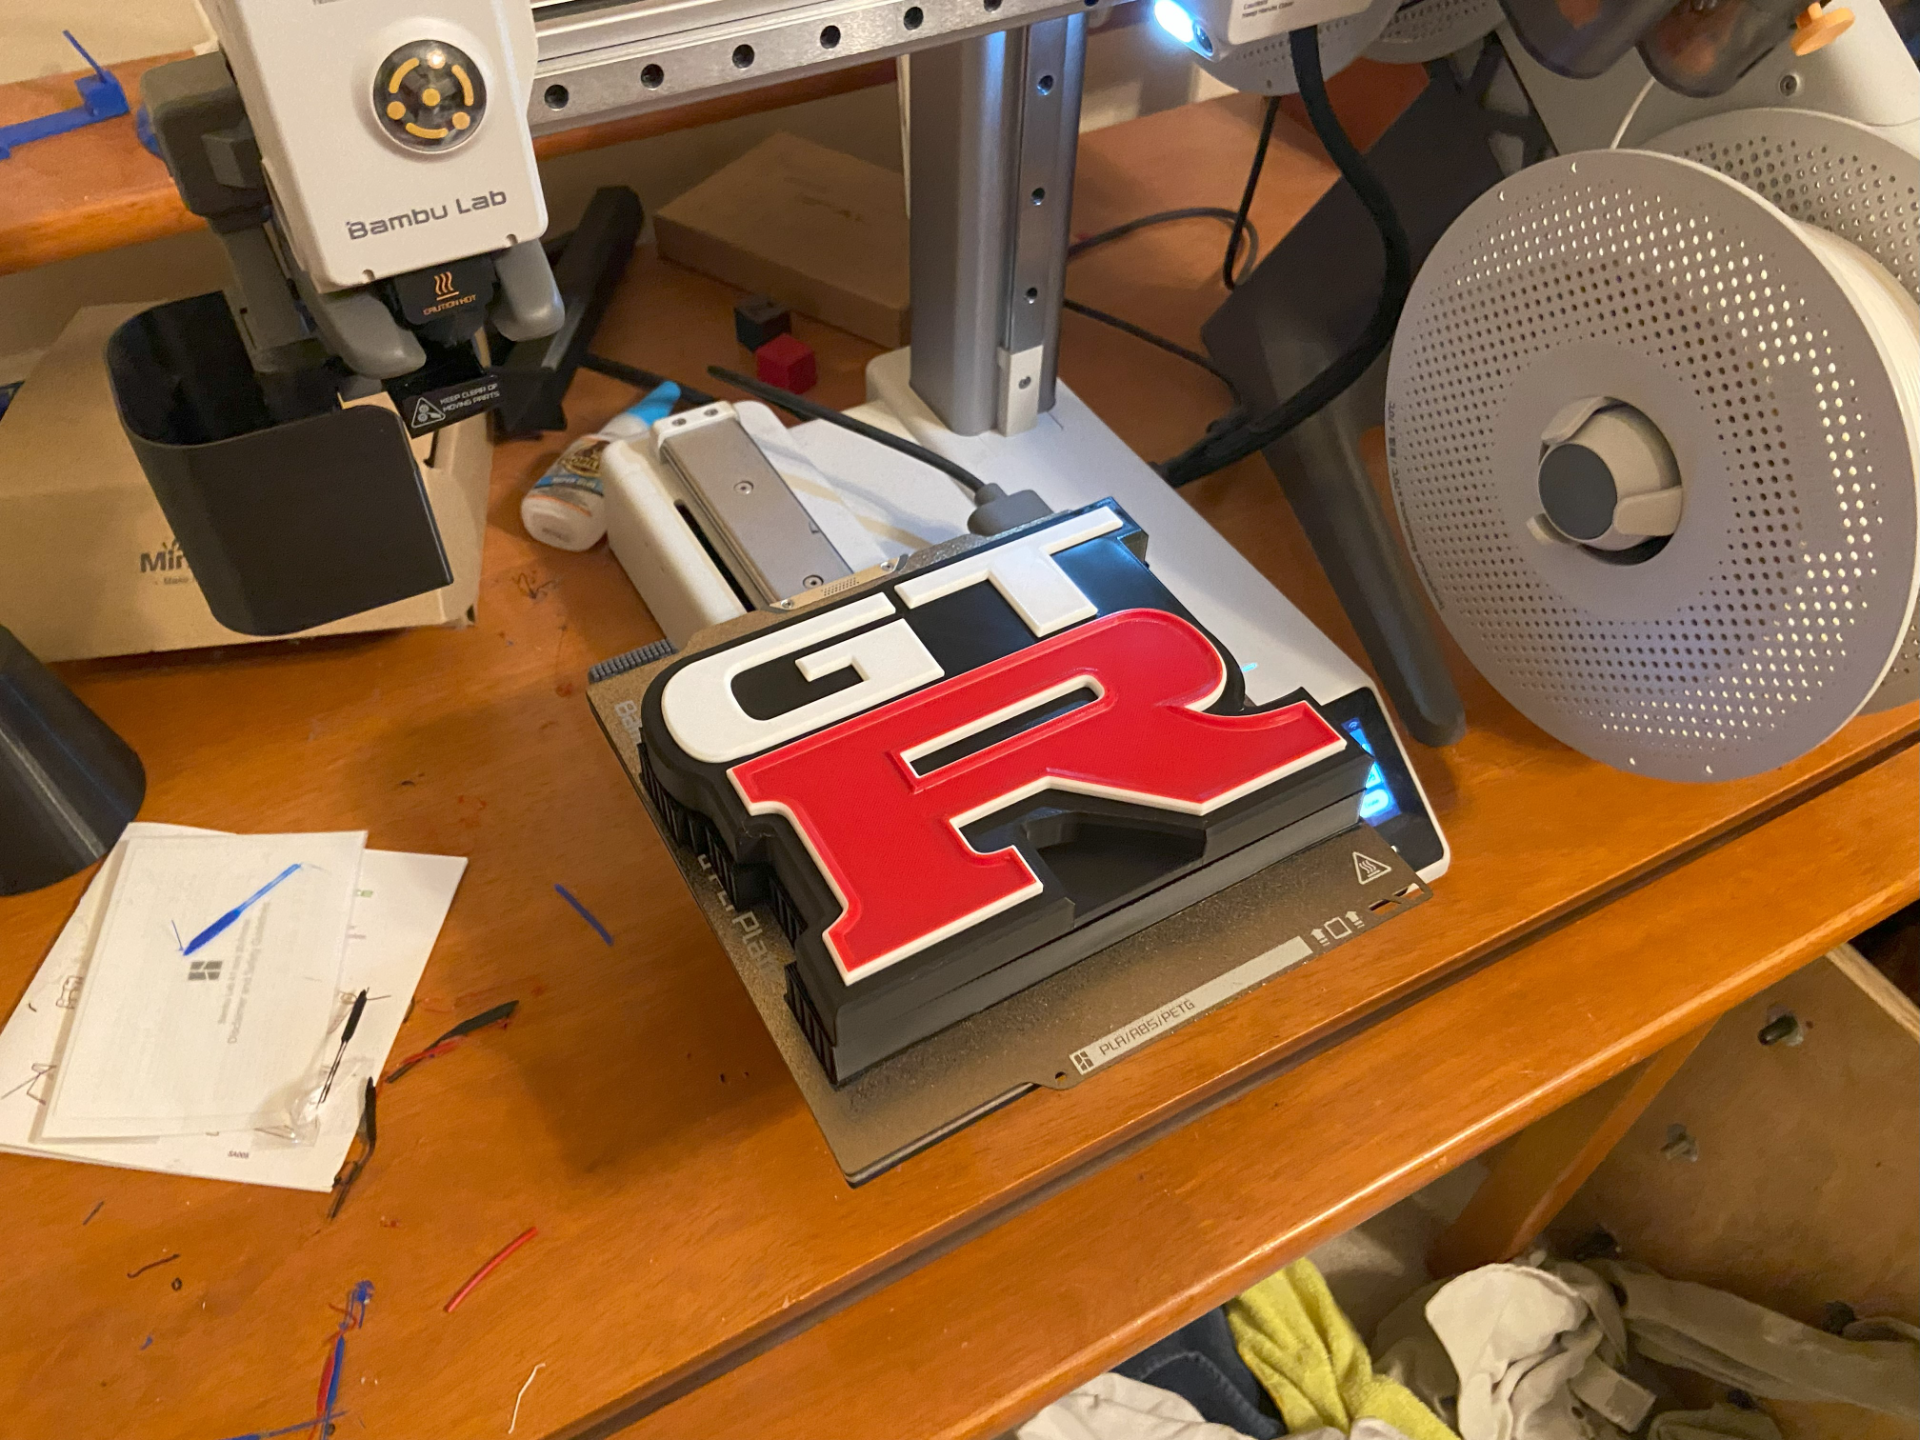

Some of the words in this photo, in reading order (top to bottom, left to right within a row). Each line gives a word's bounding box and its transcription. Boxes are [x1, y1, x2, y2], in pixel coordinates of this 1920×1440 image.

[345, 205, 449, 240] Bambu
[455, 190, 507, 214] Lab
[423, 302, 459, 316] CAUTION
[460, 294, 476, 305] HOT
[440, 394, 460, 405] KEEP
[462, 386, 486, 399] CLEAR
[487, 383, 498, 392] OF
[443, 399, 472, 412] MOVING
[473, 391, 500, 404] PARTS
[1099, 1000, 1195, 1056] PLA/ABS/PETG
